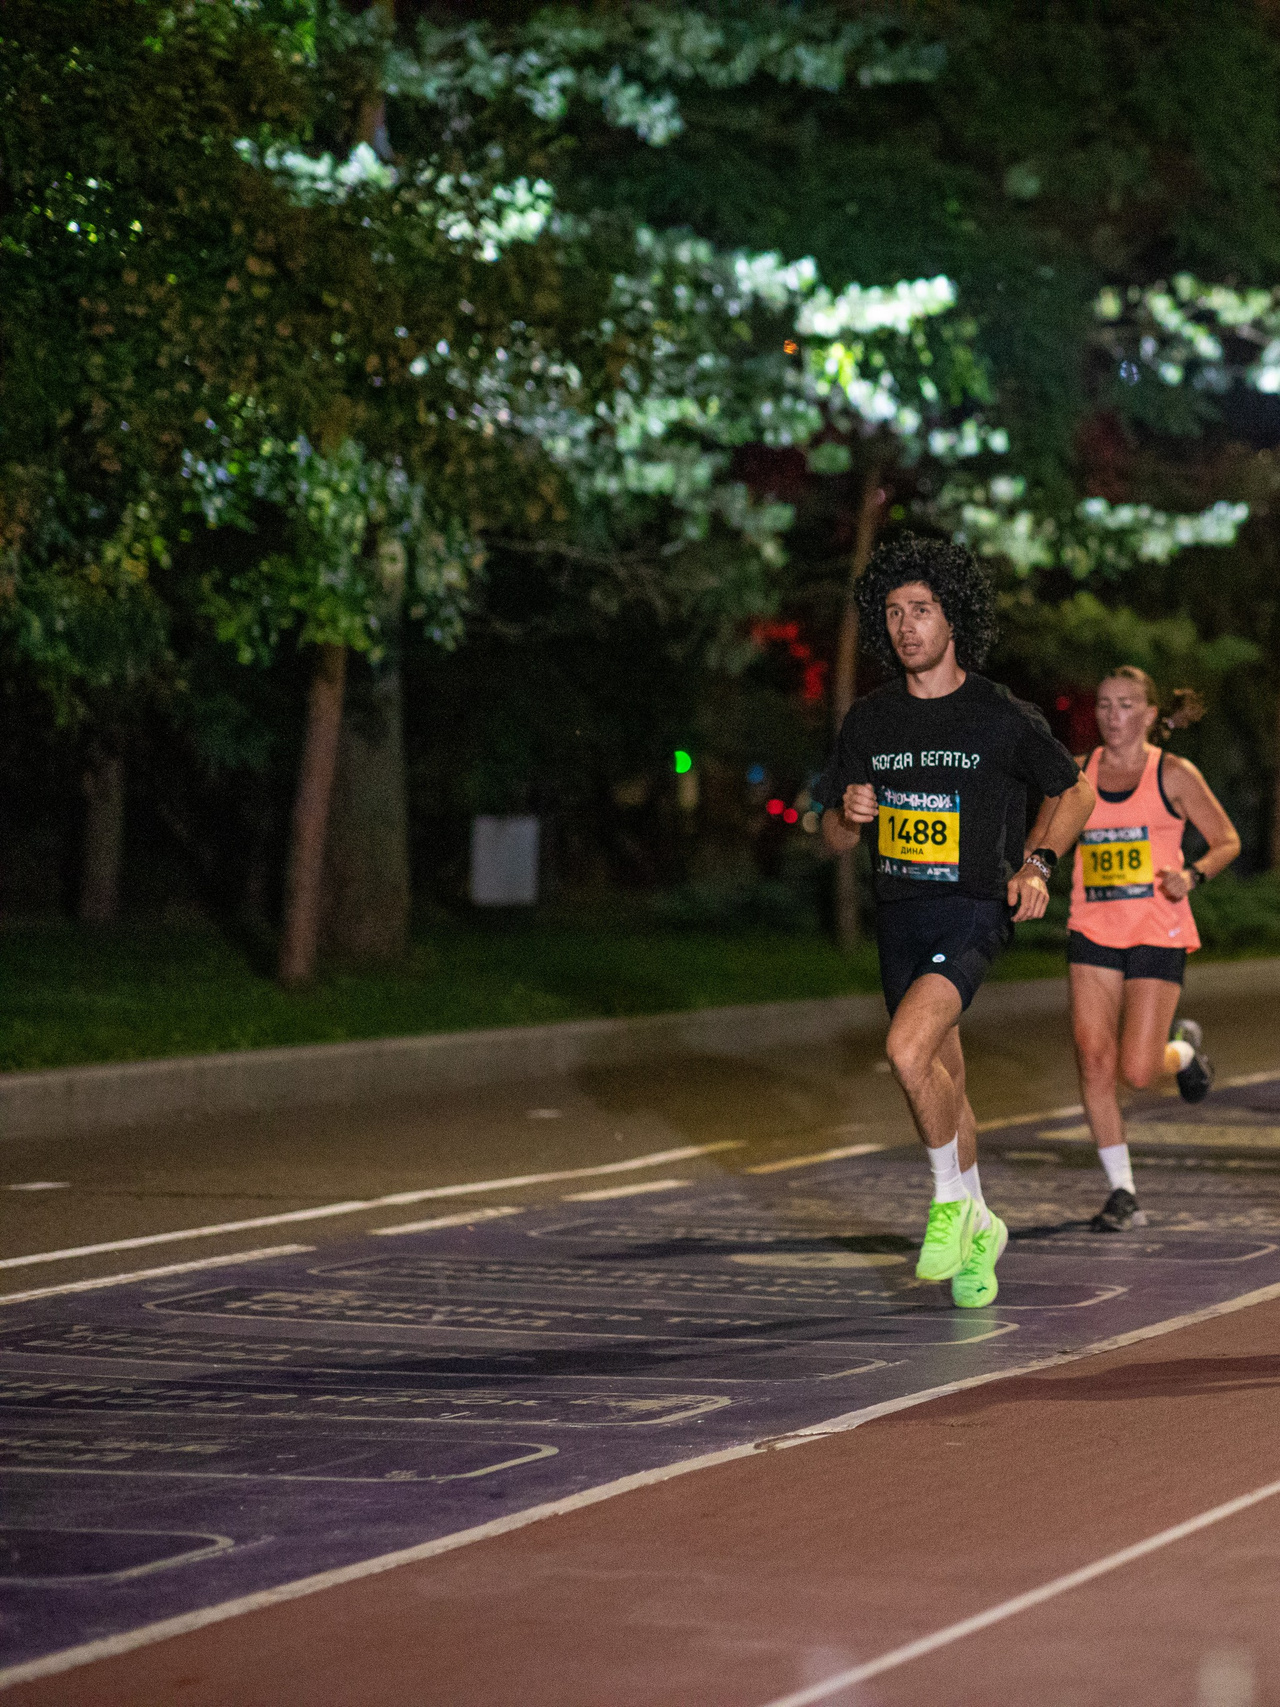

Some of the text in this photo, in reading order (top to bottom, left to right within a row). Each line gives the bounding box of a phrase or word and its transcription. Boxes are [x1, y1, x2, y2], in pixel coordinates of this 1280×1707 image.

[871, 750, 980, 770] КОГДА БЕГАТЬ?
[887, 815, 947, 845] 1488
[900, 846, 924, 855] ДИНА
[1090, 848, 1141, 872] 1818
[223, 1300, 300, 1311] 10
[22, 1340, 293, 1361] вперед
[62, 1331, 537, 1362] Наклонитесь
[0, 1380, 299, 1400] нимите
[310, 1395, 552, 1406] носок
[52, 1395, 246, 1408] ноги
